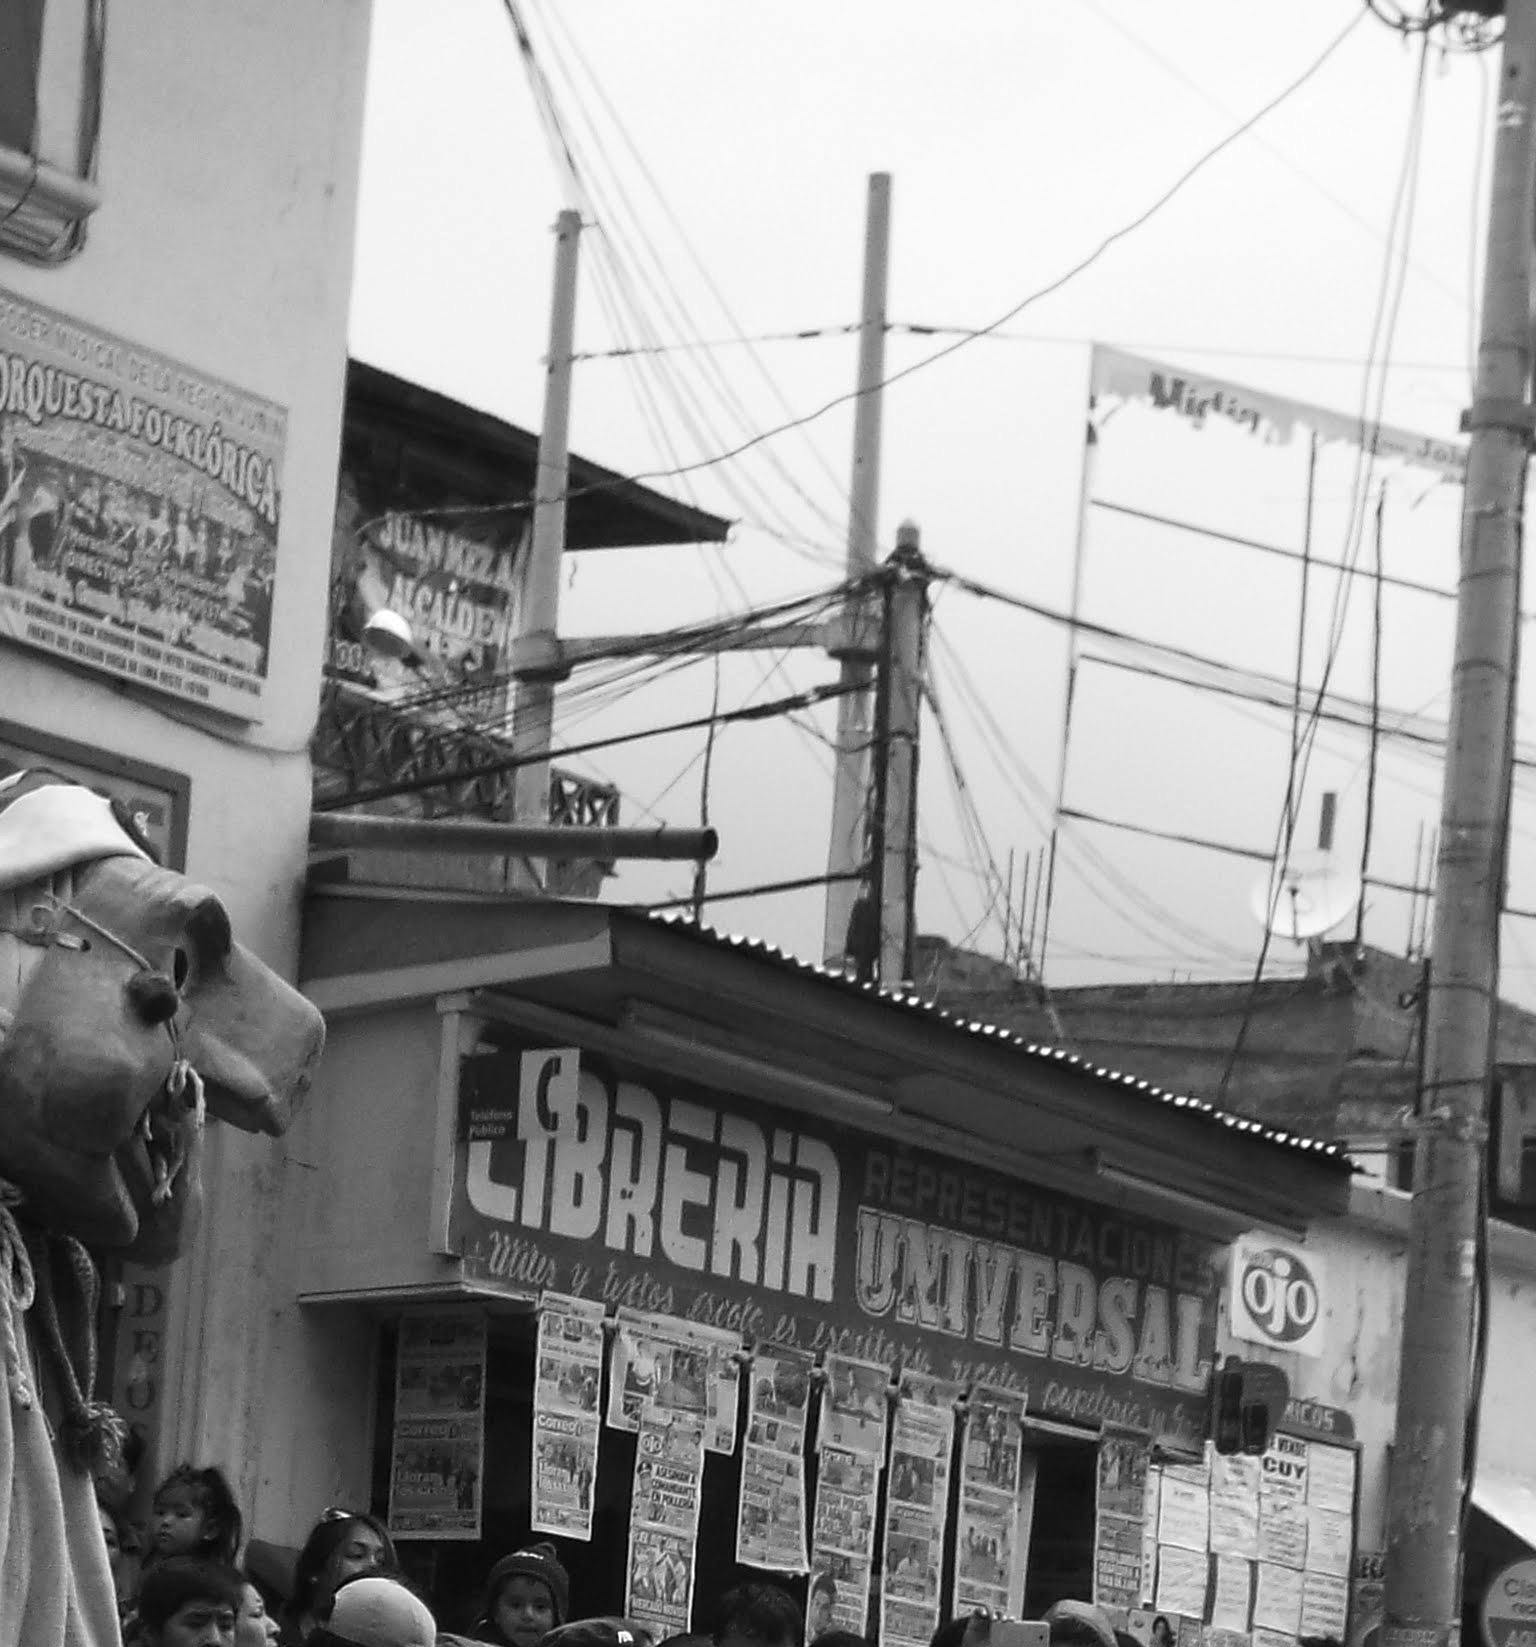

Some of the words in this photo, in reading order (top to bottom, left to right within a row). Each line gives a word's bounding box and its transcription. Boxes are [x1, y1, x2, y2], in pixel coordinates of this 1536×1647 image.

[854, 1203, 1210, 1397] UNIVERSAL
[1244, 1256, 1318, 1334] ojo
[1263, 1456, 1307, 1480] CUY
